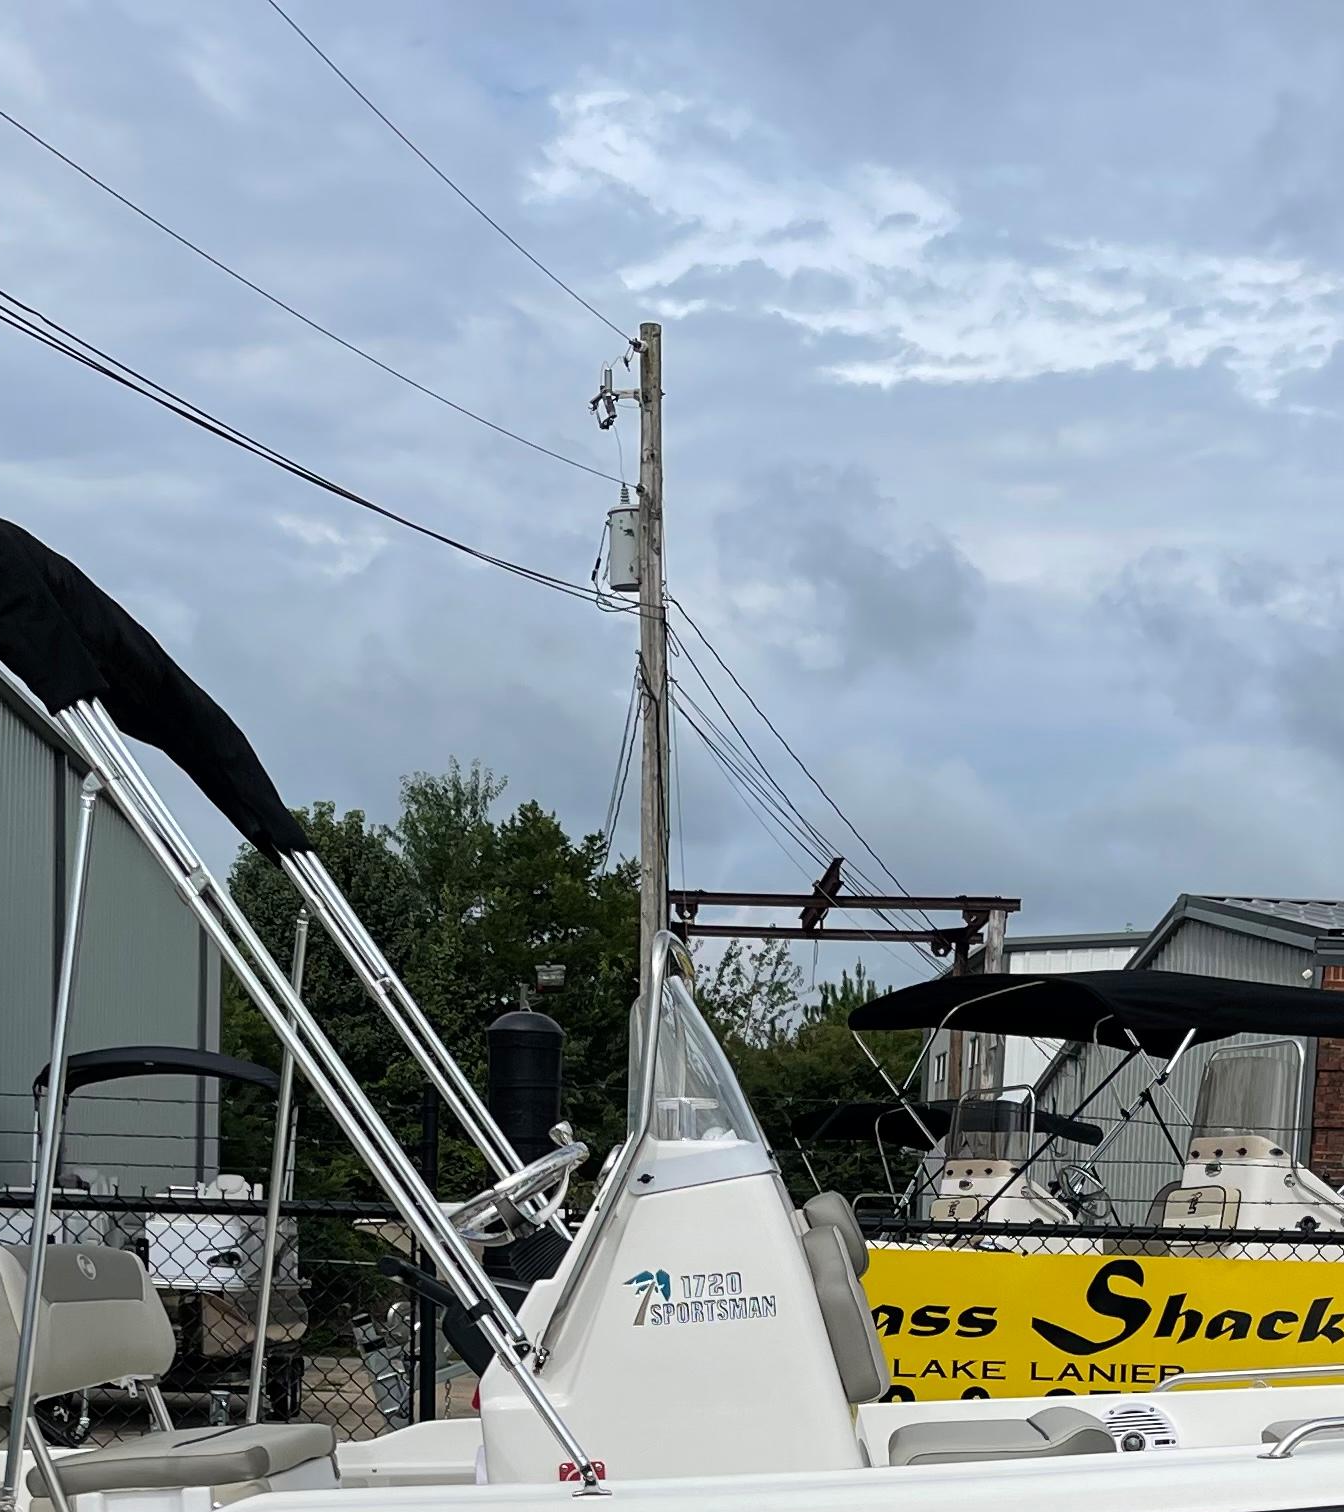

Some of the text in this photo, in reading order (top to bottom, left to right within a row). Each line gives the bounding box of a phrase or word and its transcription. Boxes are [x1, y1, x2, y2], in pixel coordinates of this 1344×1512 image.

[680, 1271, 743, 1299] 1720
[651, 1295, 777, 1327] SPORTSMAN
[871, 1304, 998, 1338] ass
[893, 1358, 1007, 1381] LAKE
